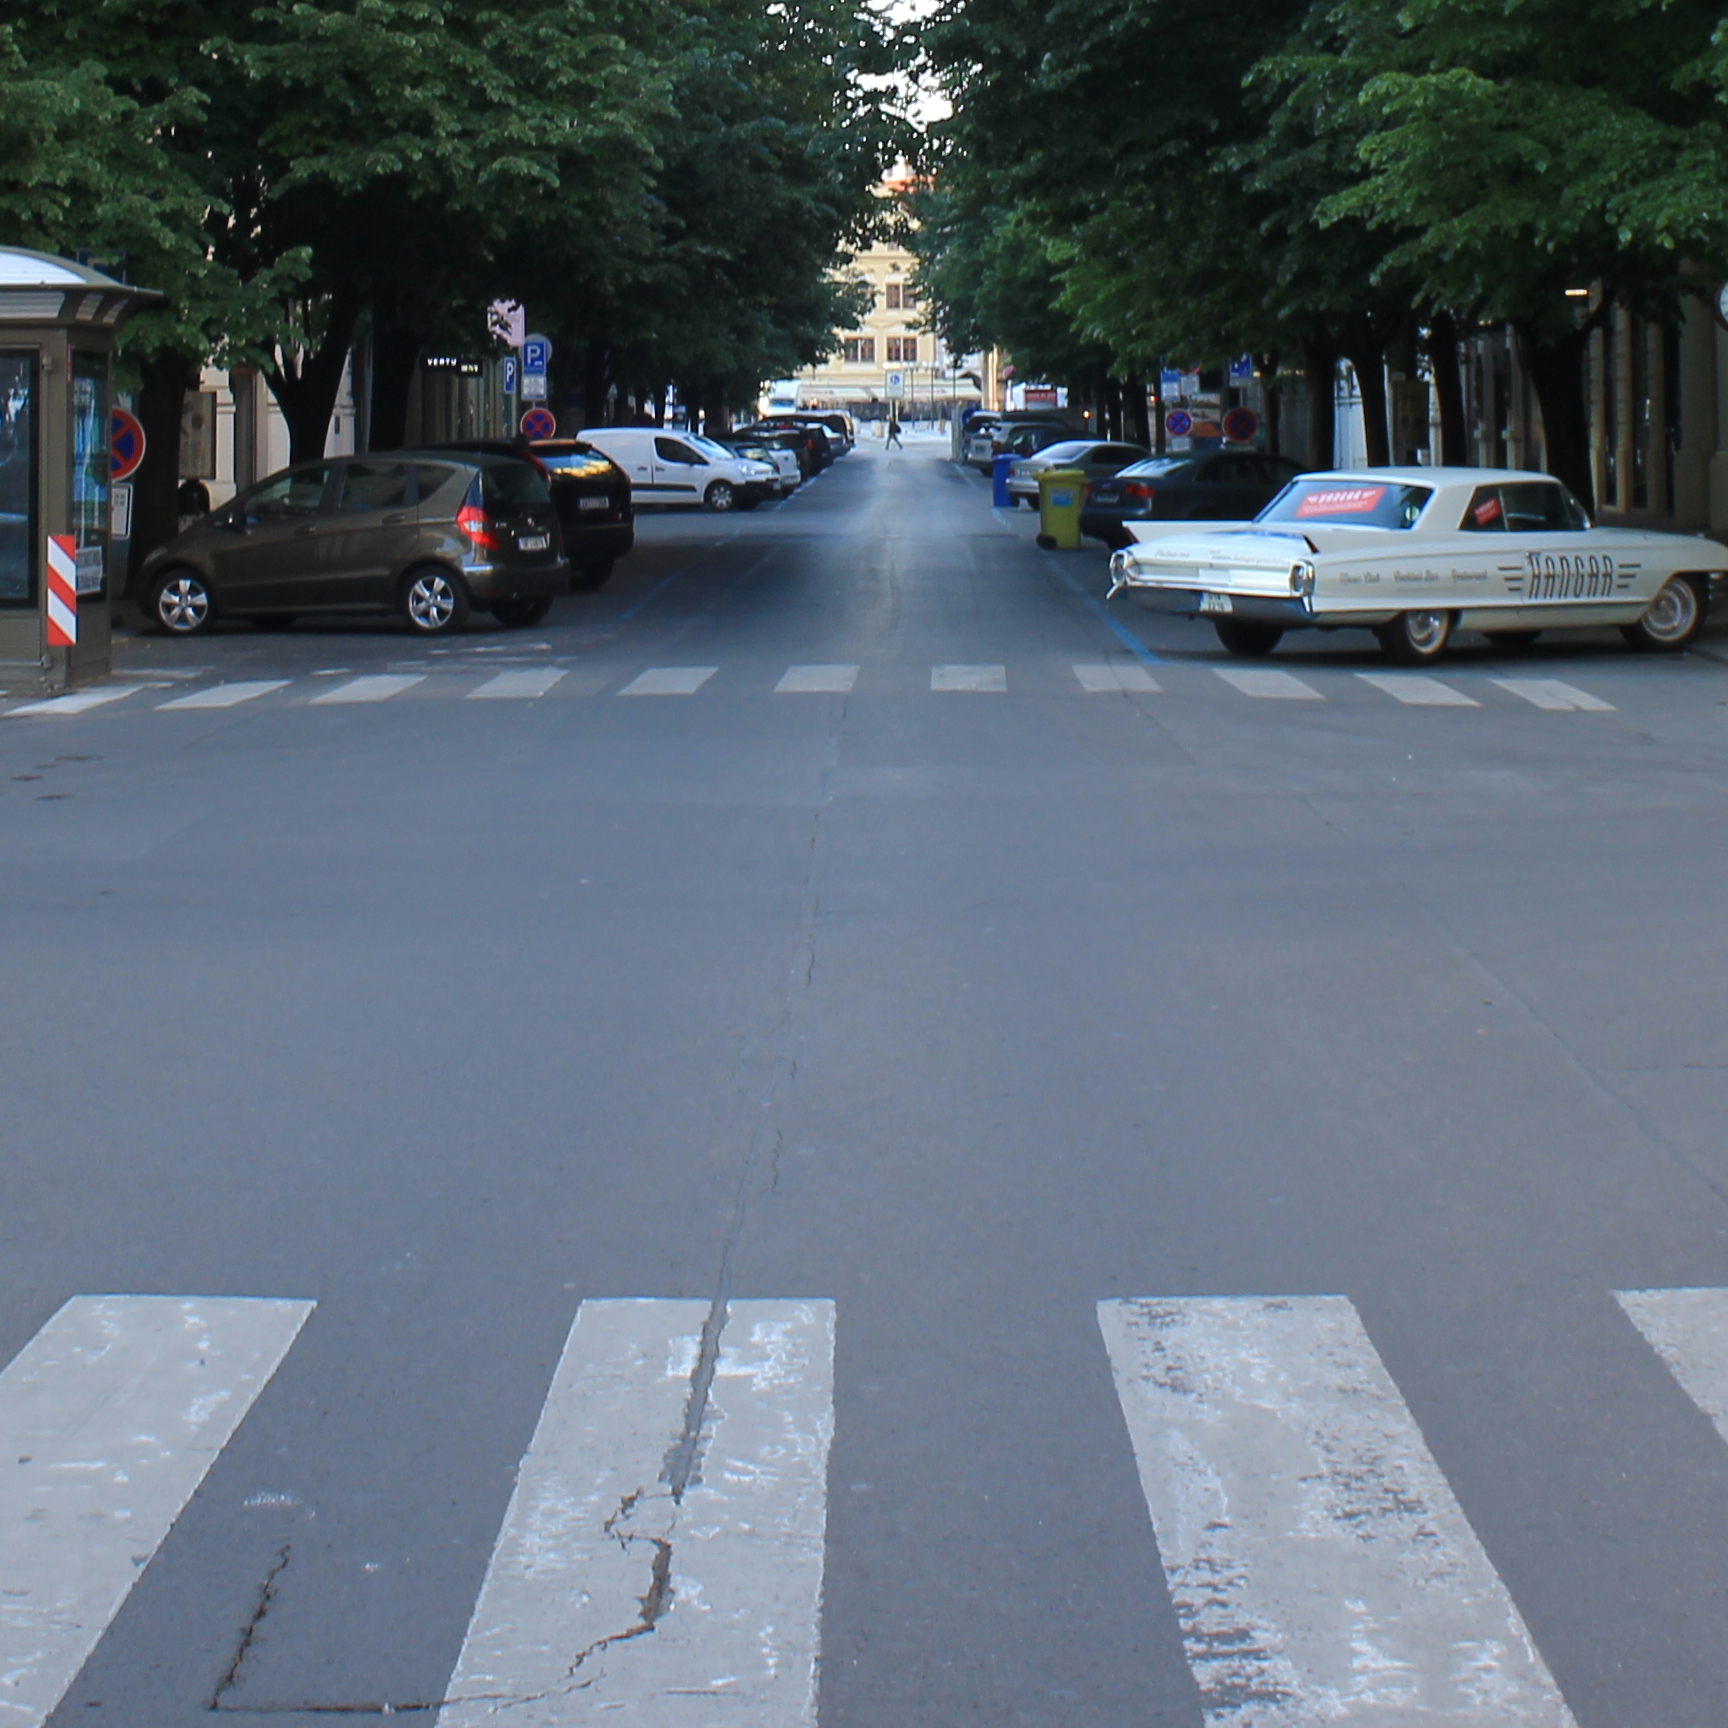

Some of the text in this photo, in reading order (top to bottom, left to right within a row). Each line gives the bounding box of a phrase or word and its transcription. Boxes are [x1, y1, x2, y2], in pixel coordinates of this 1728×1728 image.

[427, 358, 457, 366] VERTU
[506, 362, 514, 382] P
[1527, 553, 1614, 598] HANGAR
